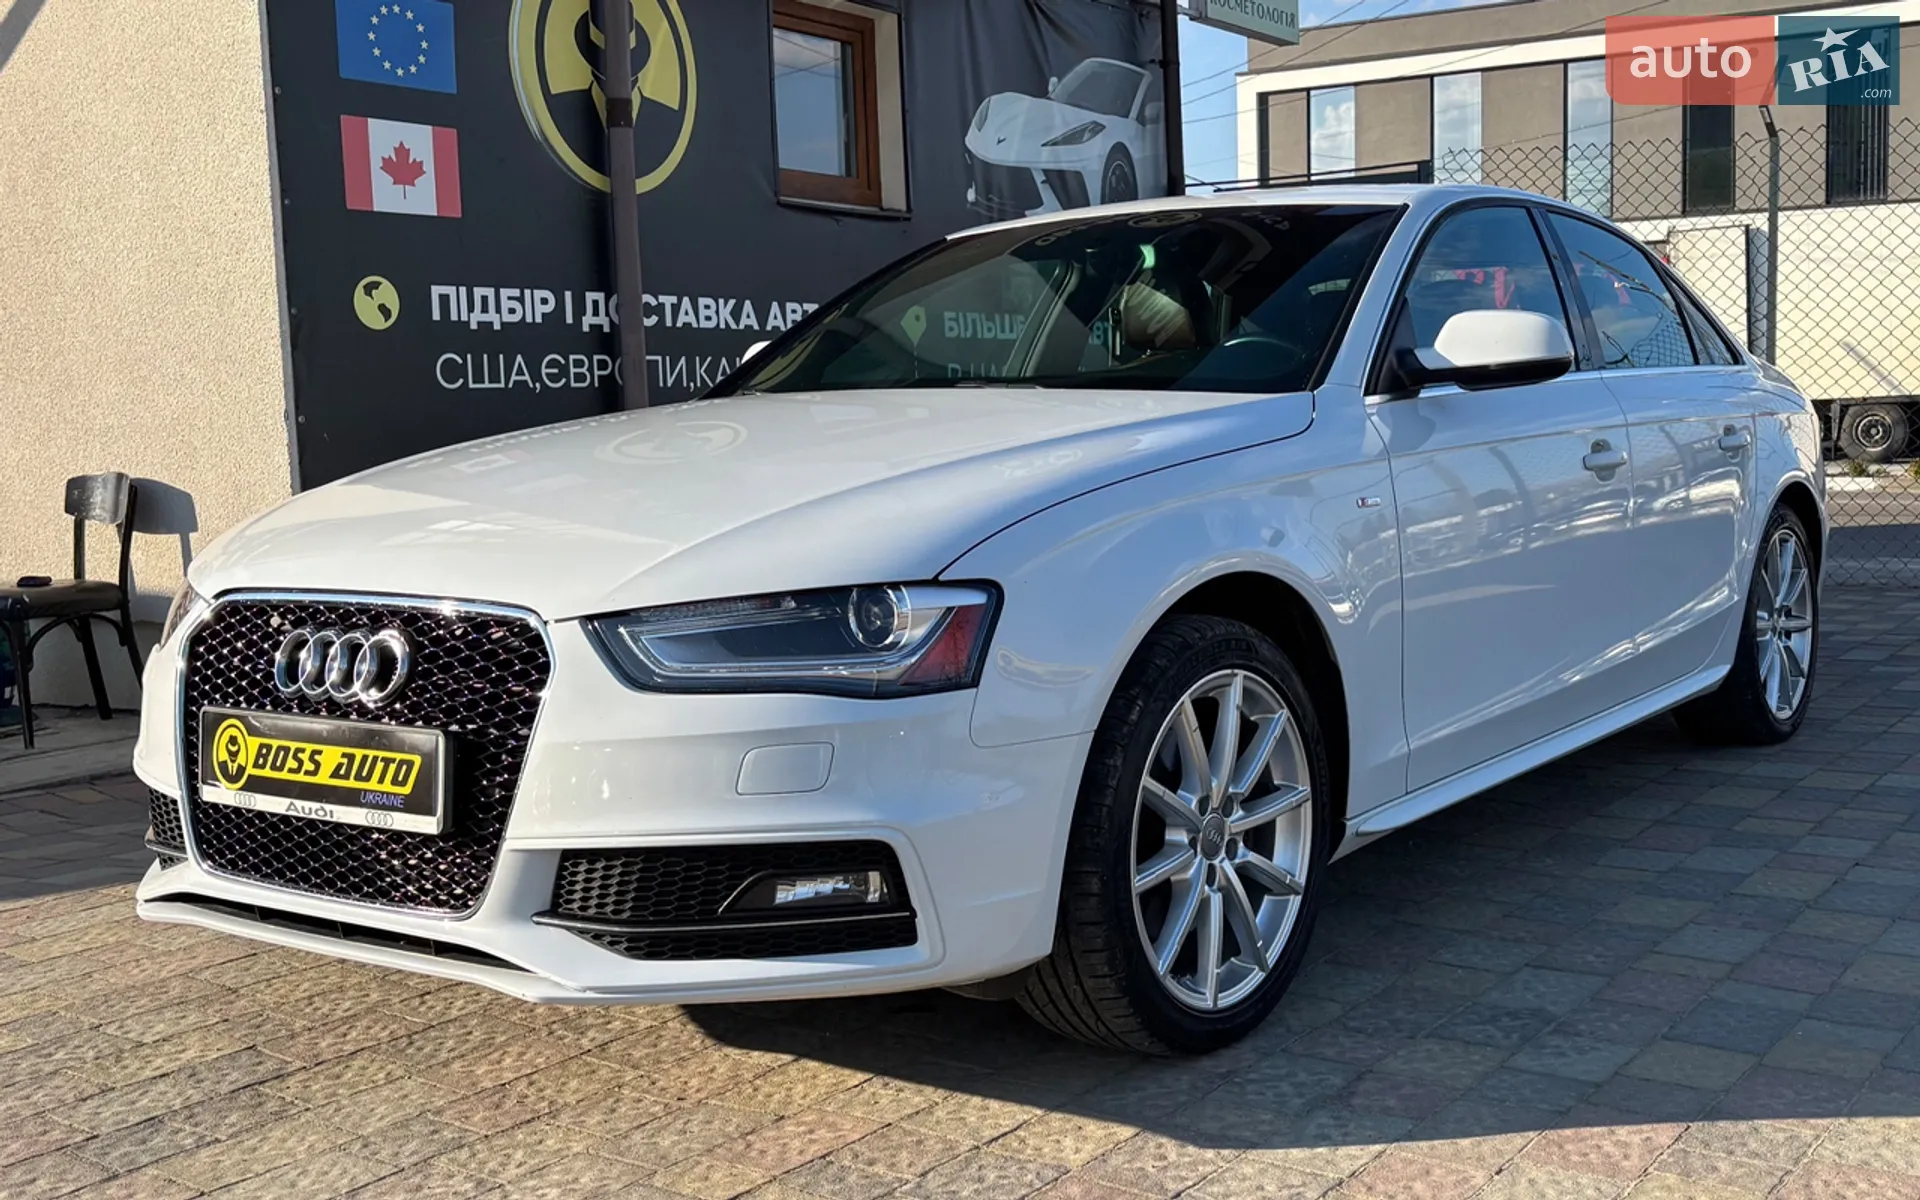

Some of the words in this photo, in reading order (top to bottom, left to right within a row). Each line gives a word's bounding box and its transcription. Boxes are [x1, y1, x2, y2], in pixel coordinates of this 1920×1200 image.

[430, 285, 556, 330] ПІДБІР
[564, 290, 573, 324] І
[436, 352, 740, 393] США,ЄВРПИ,КА
[252, 742, 324, 777] BOSS
[329, 751, 416, 788] AUTO
[285, 800, 334, 819] Audi
[360, 791, 406, 808] UKRAINE
